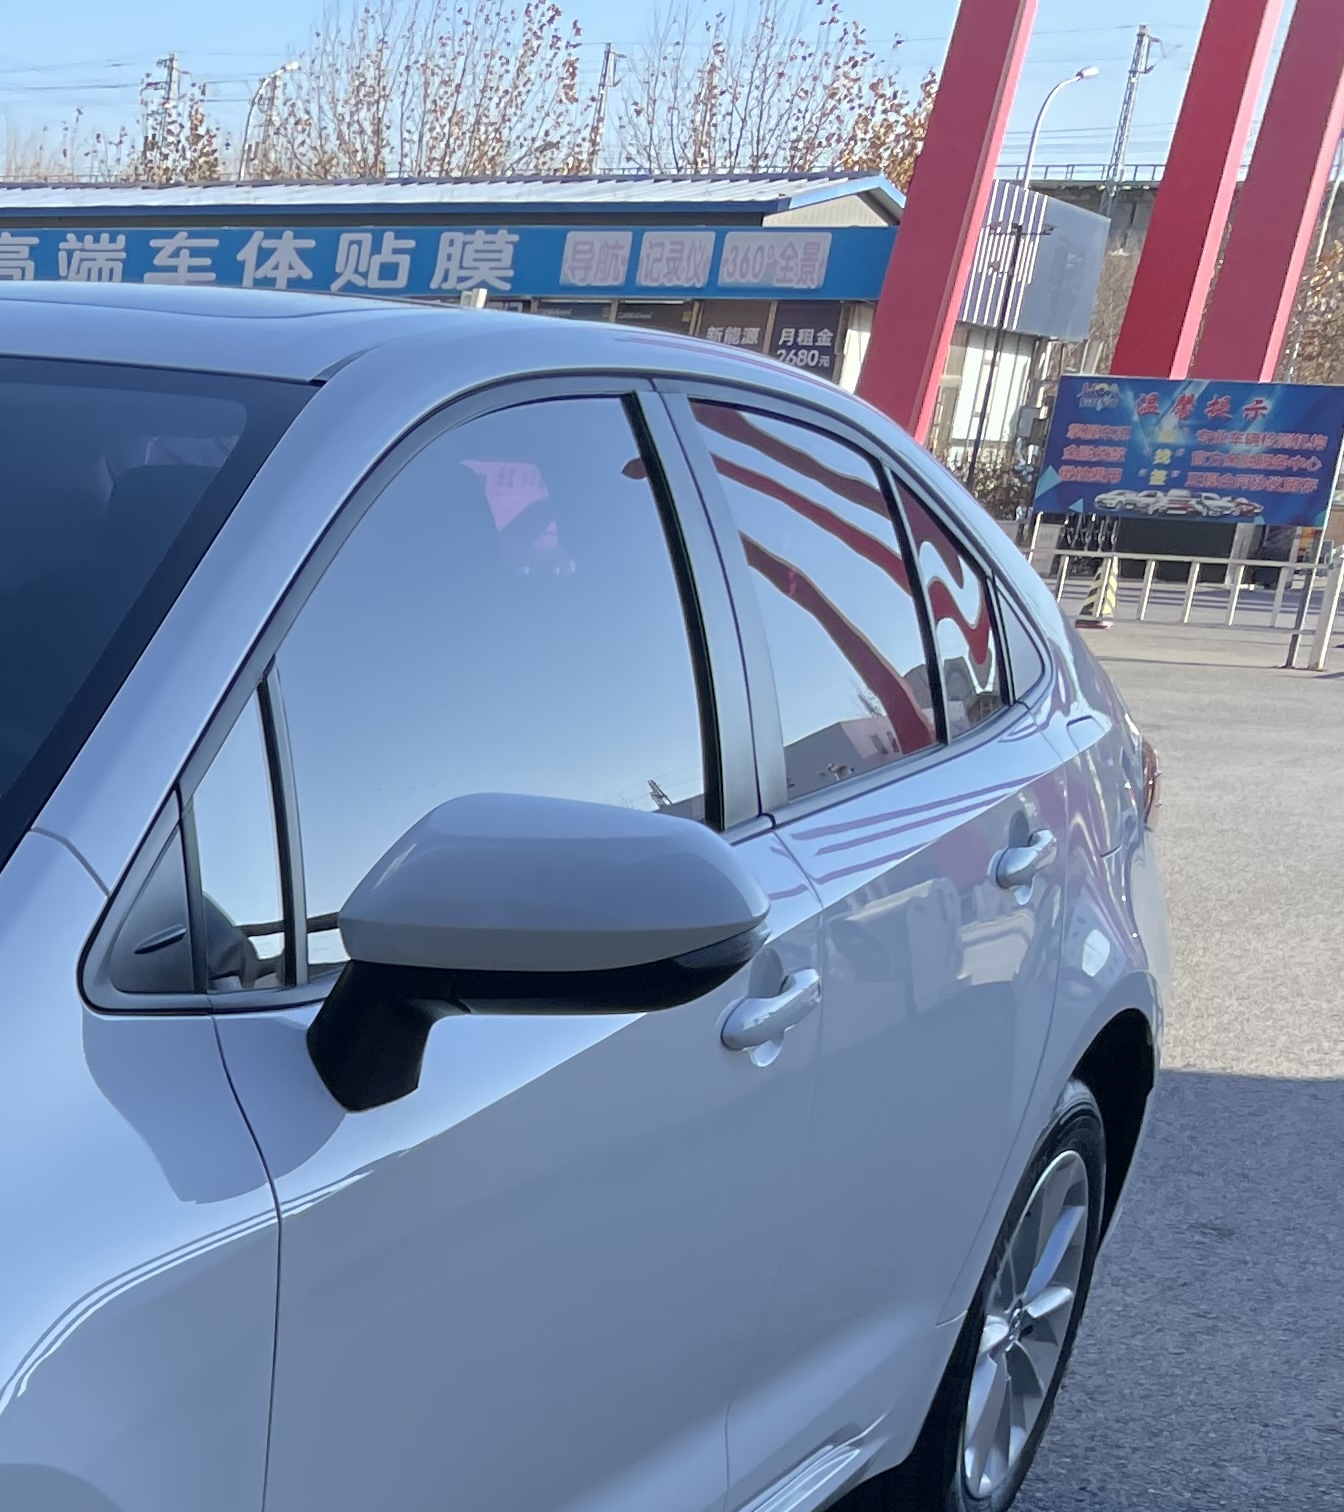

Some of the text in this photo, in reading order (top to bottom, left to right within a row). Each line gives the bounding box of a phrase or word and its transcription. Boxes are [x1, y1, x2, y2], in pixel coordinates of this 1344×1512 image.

[568, 240, 625, 283] 导航
[643, 240, 707, 287] 记录仪
[706, 325, 759, 345] 新能源
[778, 328, 833, 347] 月租金
[1136, 391, 1269, 421] 温馨提示
